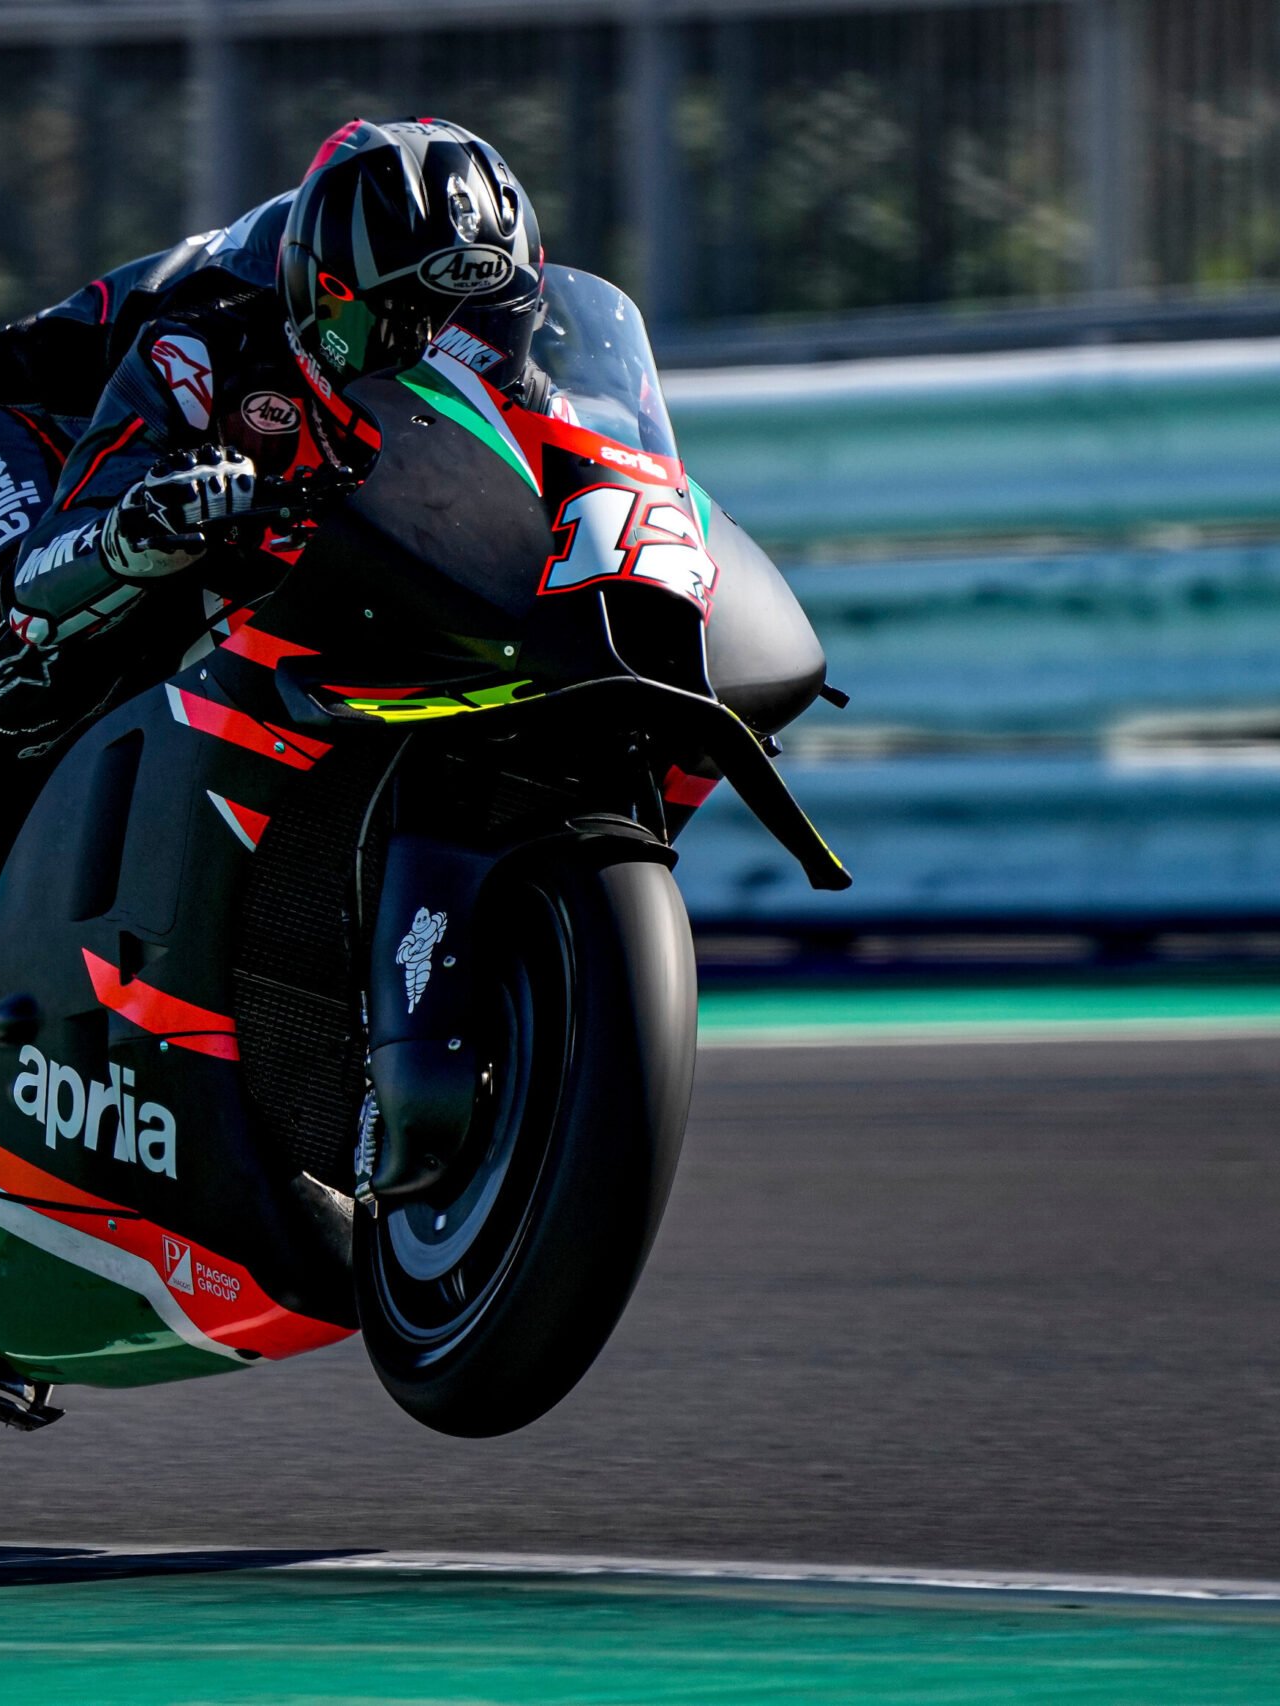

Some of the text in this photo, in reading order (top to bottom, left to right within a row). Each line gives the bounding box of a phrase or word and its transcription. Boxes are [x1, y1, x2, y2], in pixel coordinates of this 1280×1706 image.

[426, 250, 507, 281] Arai
[320, 338, 346, 367] LANG
[246, 397, 296, 425] Arai
[536, 482, 720, 627] 12
[195, 1262, 241, 1291] PIAGGIO
[197, 1277, 237, 1302] GROUP
